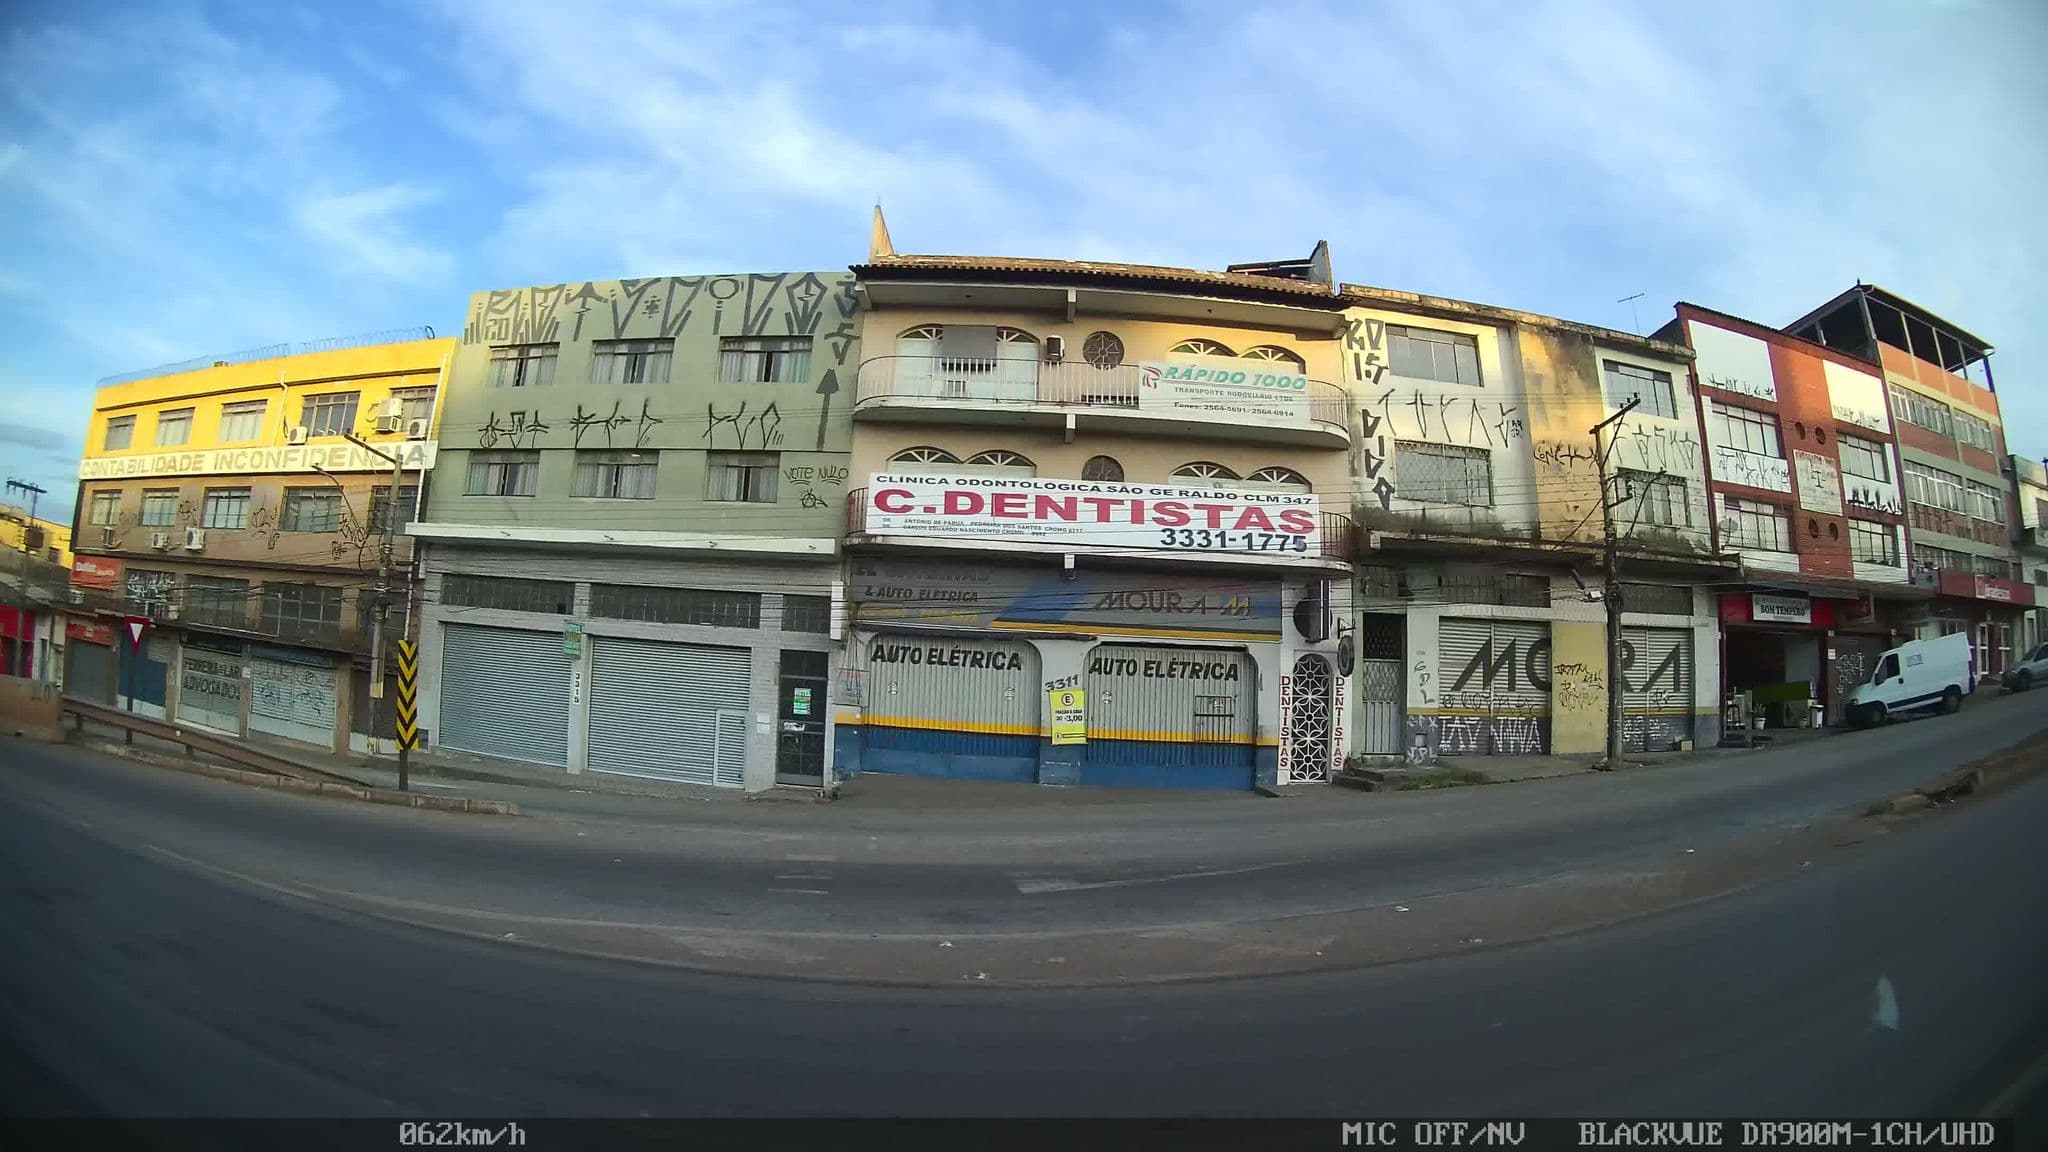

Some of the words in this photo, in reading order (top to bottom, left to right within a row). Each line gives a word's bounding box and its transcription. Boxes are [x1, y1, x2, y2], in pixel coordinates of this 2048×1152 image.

[1164, 364, 1247, 384] RÁPIDO
[82, 454, 205, 477] CONTABILIDADE
[1106, 484, 1143, 495] SÃO
[1178, 490, 1237, 500] RALDO
[1243, 494, 1279, 504] CLM
[1283, 496, 1313, 505] 347
[874, 488, 1315, 535] C.DENTISTAS
[1160, 528, 1308, 552] 3331-1775
[876, 587, 913, 599] AUTO
[1097, 592, 1208, 615] MOURA
[871, 645, 922, 665] AUTO
[926, 646, 1022, 671] ELÉTRICA
[1089, 657, 1138, 677] AUTO
[1143, 658, 1239, 682] ELÉTRICA
[1044, 674, 1079, 692] 3311
[1280, 676, 1291, 767] DENTISTAS
[1333, 677, 1345, 767] DENTISTAS
